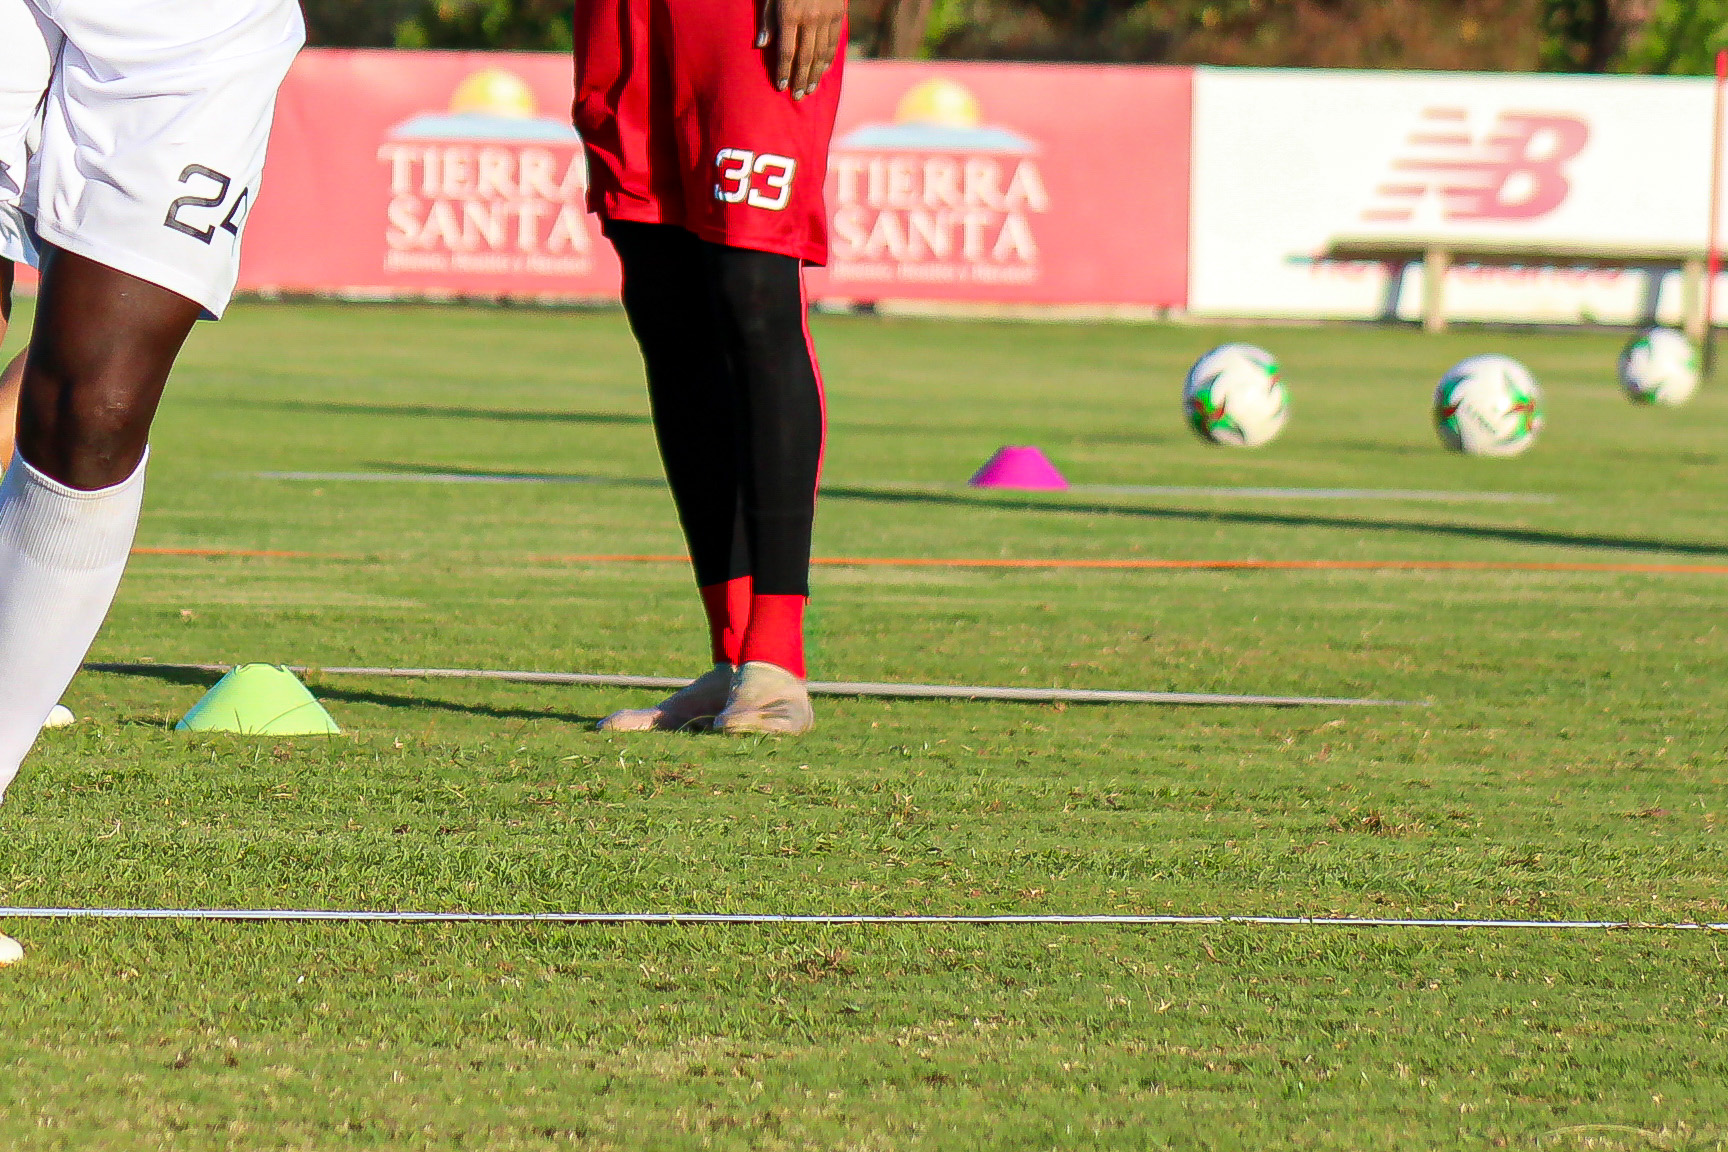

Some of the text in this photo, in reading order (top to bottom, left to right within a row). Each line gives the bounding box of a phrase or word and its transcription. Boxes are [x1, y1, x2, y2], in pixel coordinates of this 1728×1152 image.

[376, 144, 588, 201] TIERRA
[714, 147, 797, 212] 33
[829, 155, 1050, 213] TIERRA
[384, 196, 592, 253] SANTA
[832, 205, 1041, 263] SANTA
